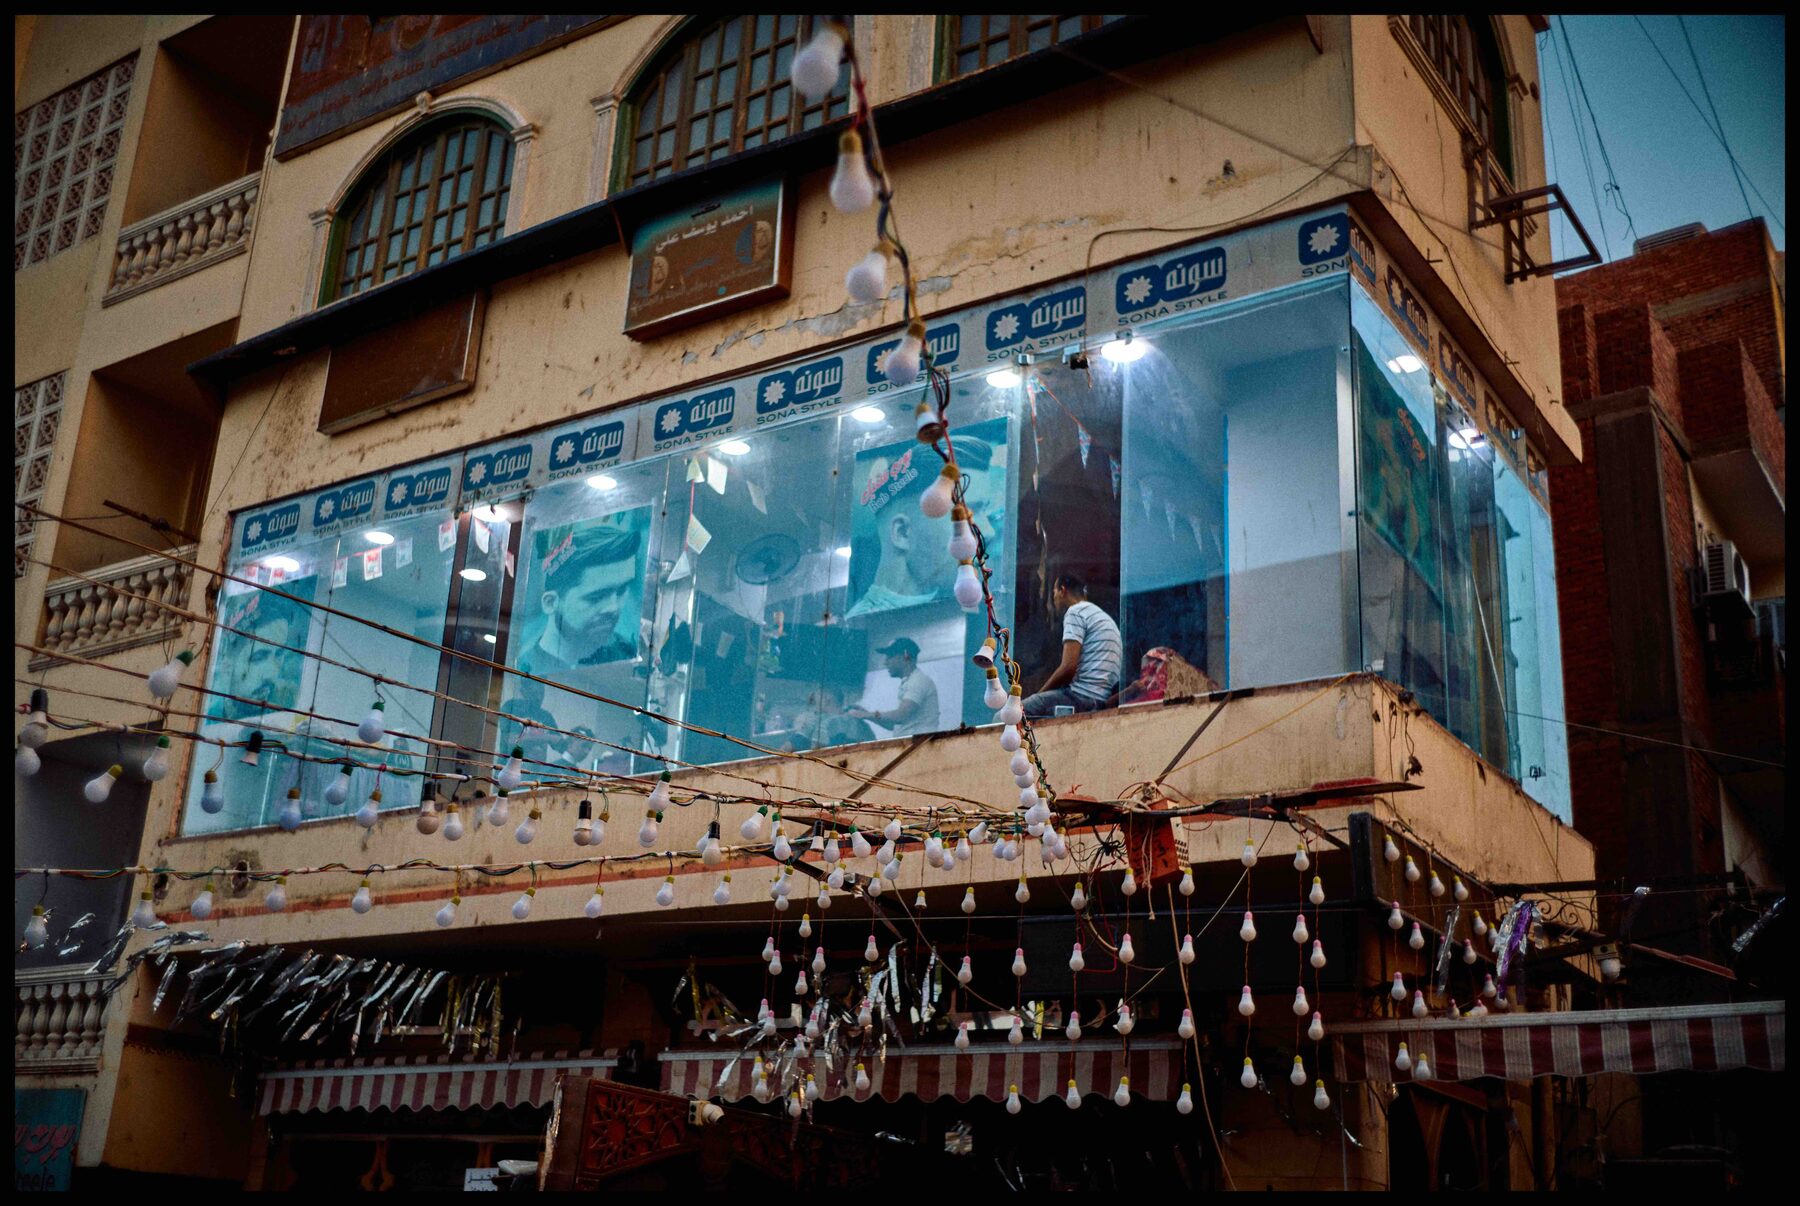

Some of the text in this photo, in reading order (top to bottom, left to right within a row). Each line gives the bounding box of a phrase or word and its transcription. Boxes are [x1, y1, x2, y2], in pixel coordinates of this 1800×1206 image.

[1301, 258, 1346, 278] SON
[1117, 290, 1227, 327] SONA STYLE
[929, 332, 958, 368] سو
[987, 329, 1087, 363] SONA STYLE
[867, 382, 905, 396] SON
[757, 396, 842, 425] SONA STYLE
[654, 426, 733, 452] SONA STYLE
[549, 458, 621, 481] SONA STYLE
